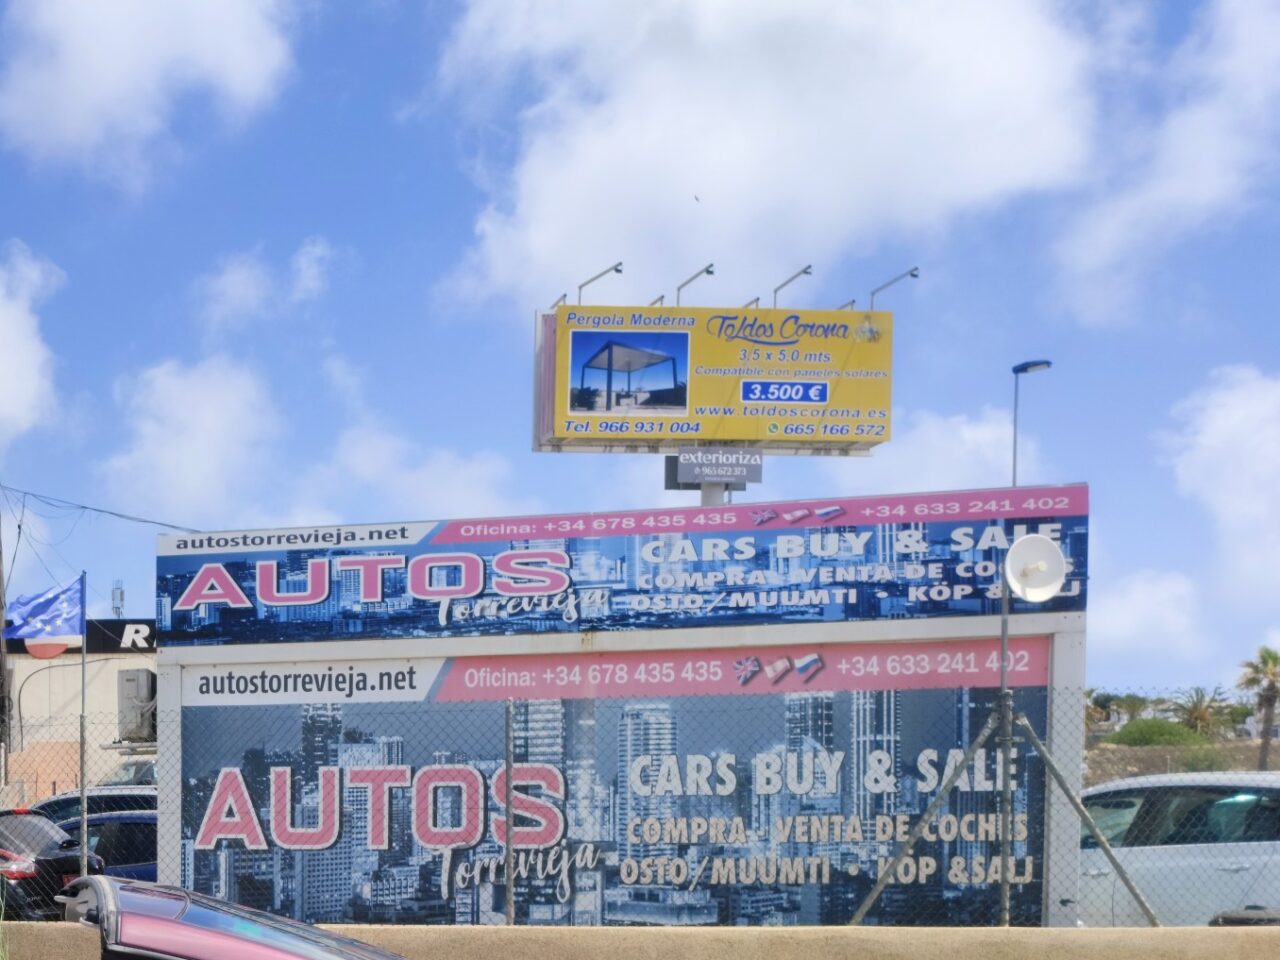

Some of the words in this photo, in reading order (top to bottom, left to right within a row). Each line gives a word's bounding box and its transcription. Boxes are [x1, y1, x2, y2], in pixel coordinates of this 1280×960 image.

[567, 312, 624, 328] Pergola
[630, 313, 695, 326] Moderna
[707, 315, 774, 343] Toldos
[780, 315, 849, 339] Corona
[695, 366, 764, 377] Compatible
[768, 369, 790, 377] con
[794, 367, 841, 379] paneles
[845, 368, 888, 378] solares
[749, 384, 804, 400] 3.500
[808, 385, 822, 400] €
[695, 405, 887, 419] www.toldoscorona.es
[598, 421, 630, 433] 966
[634, 421, 664, 433] 931
[669, 422, 701, 434] 004
[783, 424, 814, 435] 665
[821, 424, 850, 436] 166
[854, 424, 886, 436] 572
[680, 450, 762, 465] exterioriza
[861, 504, 907, 517] +34
[914, 502, 960, 515] 633
[968, 499, 1014, 512] 241
[1021, 497, 1069, 510] 402
[176, 524, 409, 550] autostorrevieja.net
[460, 521, 536, 538] Oficina:
[543, 519, 586, 533] +34
[592, 517, 636, 531] 678
[642, 515, 686, 528] 435
[692, 513, 737, 526] 435
[641, 536, 757, 563] CARS
[776, 531, 873, 559] BUY
[895, 530, 928, 554] &
[172, 549, 571, 612] AUTOS
[637, 570, 768, 590] COMPRA
[798, 563, 894, 583] VENTA
[905, 563, 944, 579] DE
[907, 582, 973, 602] KÖP
[429, 588, 610, 627] Torrevieja
[464, 667, 537, 688] Oficina:
[542, 665, 582, 686] +34
[588, 664, 629, 684] 678
[634, 663, 675, 683] 435
[681, 661, 722, 682] 435
[837, 656, 879, 677] +34
[886, 654, 930, 675] 633
[937, 652, 979, 673] 241
[198, 666, 417, 698] autostorrevieja.net
[630, 753, 738, 797] CARS
[755, 751, 846, 796] BUY
[864, 749, 898, 794] &
[916, 747, 1018, 793] SALE
[194, 763, 568, 850] AUTOS
[627, 816, 747, 844] COMPRA
[775, 815, 864, 843] VENTA
[875, 815, 910, 842] DE
[431, 838, 602, 904] Torrevieja
